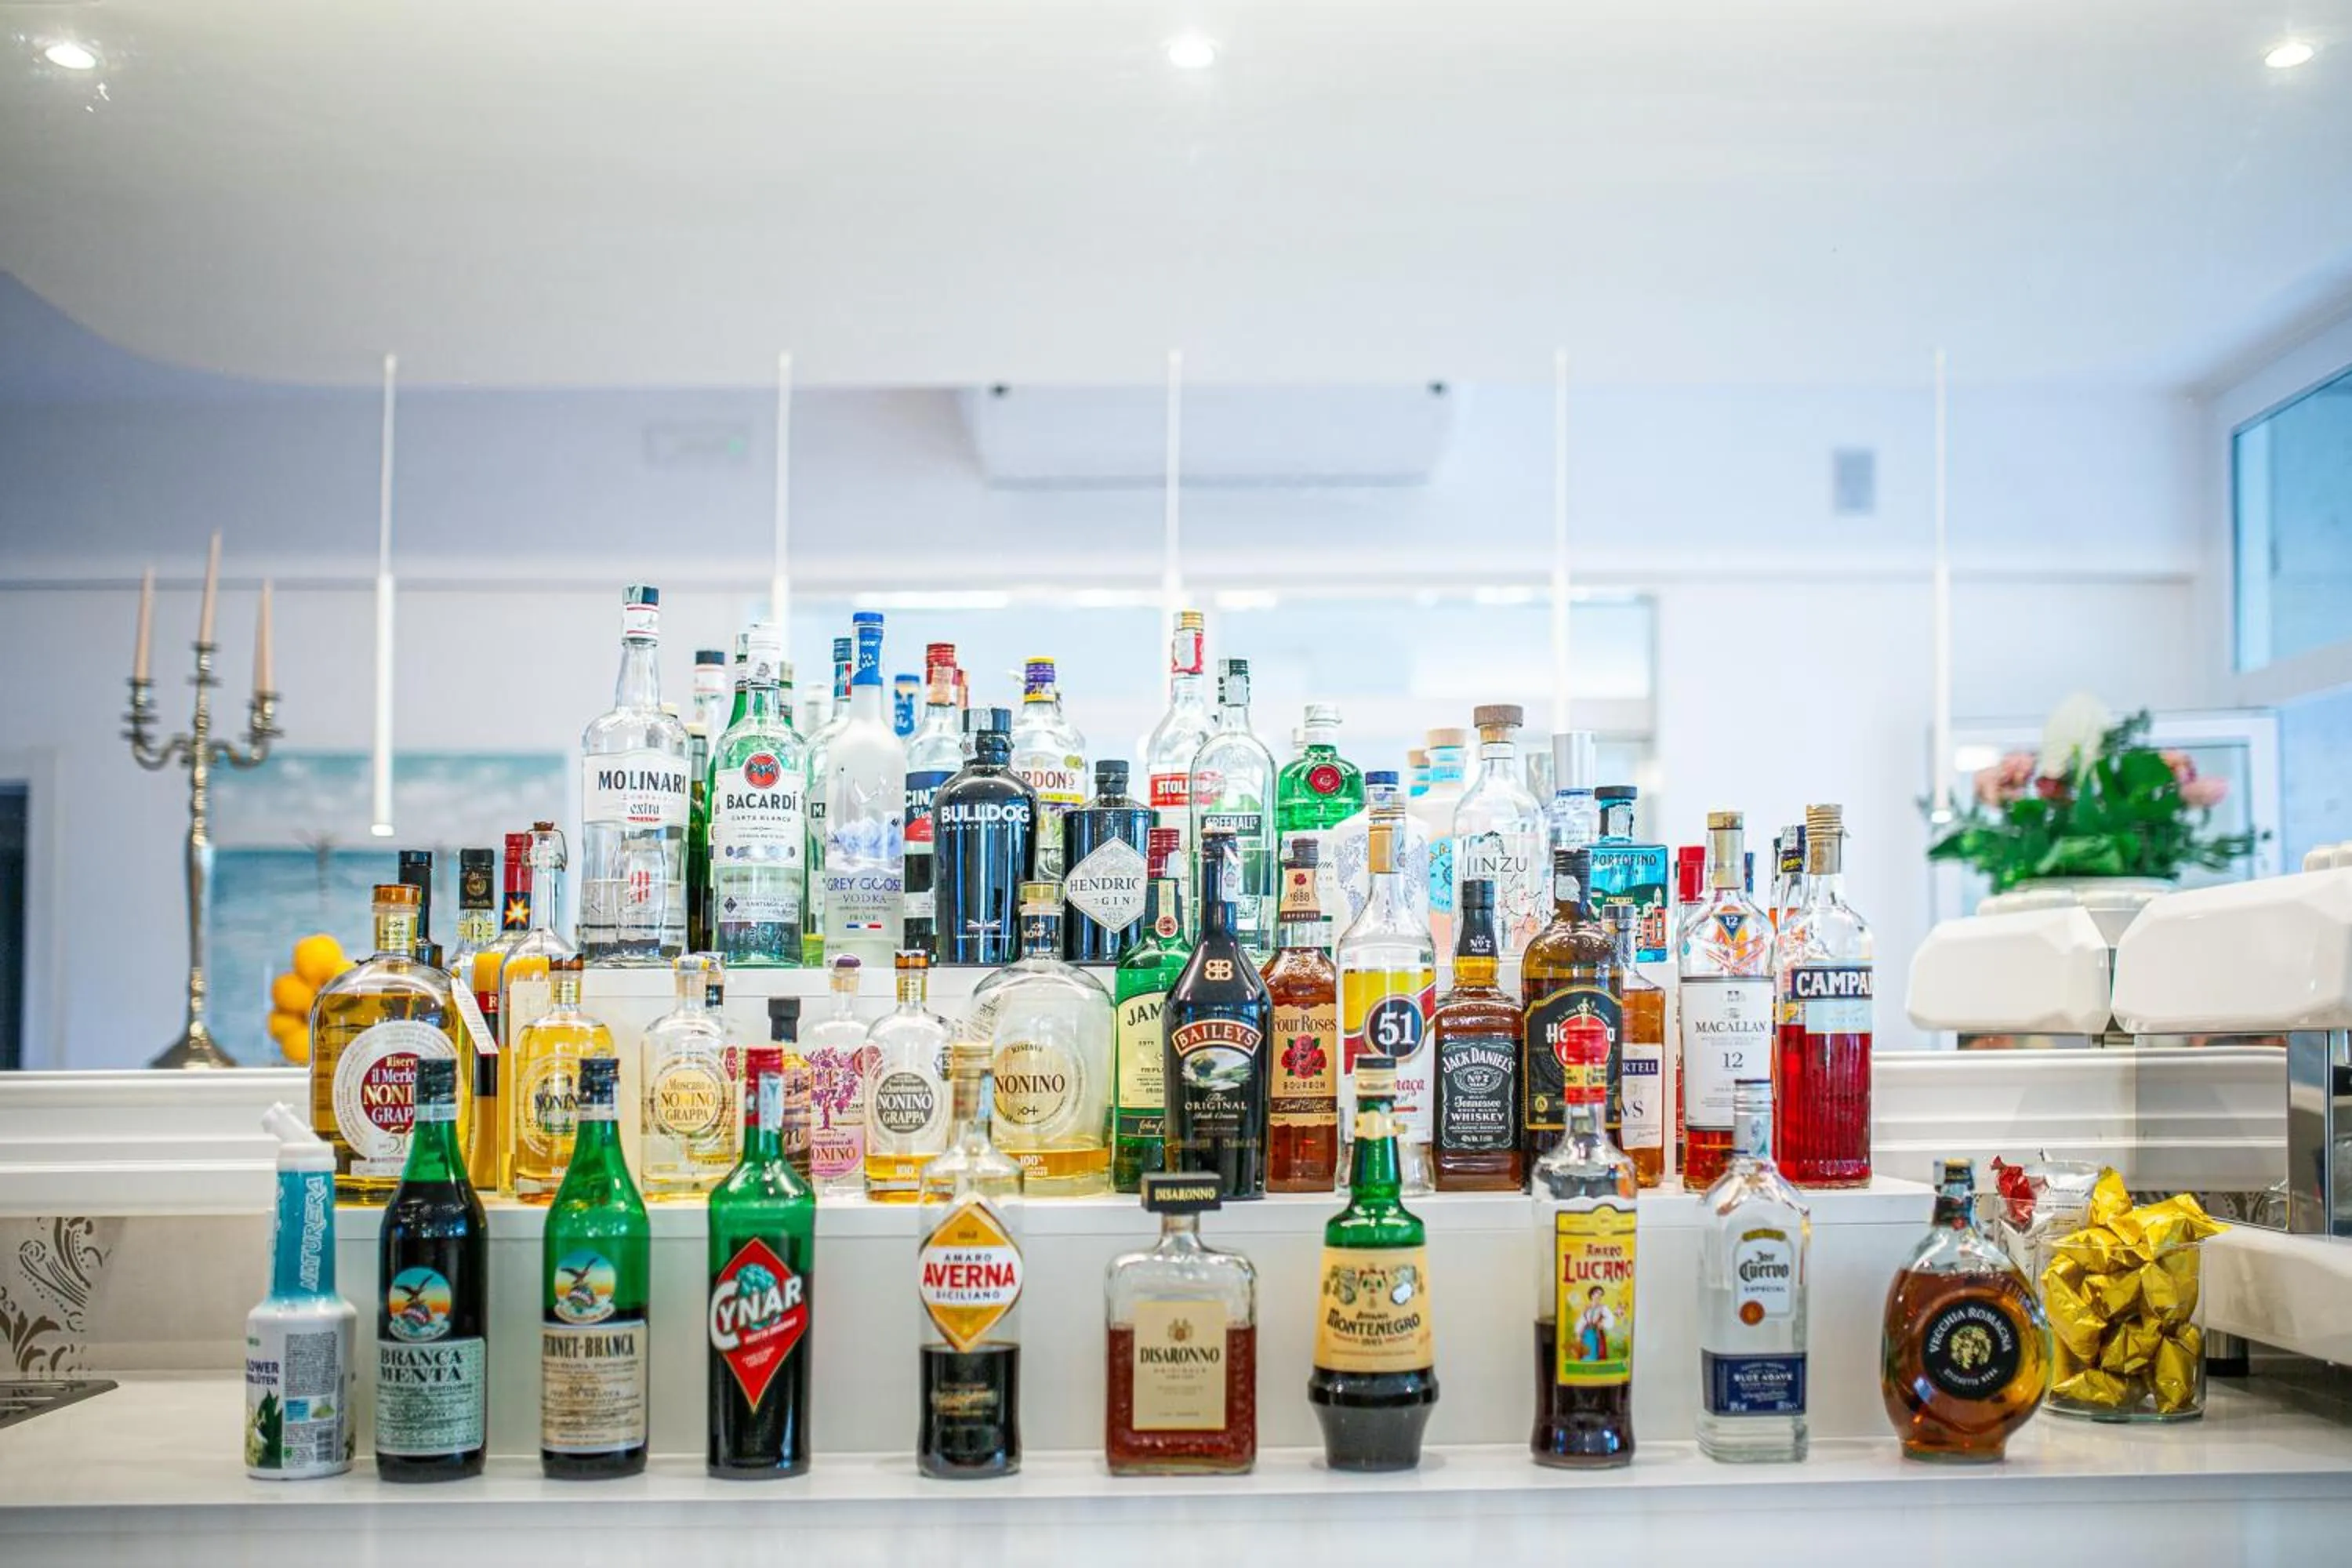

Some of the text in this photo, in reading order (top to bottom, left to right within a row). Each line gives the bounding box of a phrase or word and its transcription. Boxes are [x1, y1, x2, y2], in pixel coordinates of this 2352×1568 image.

[598, 770, 687, 793] MOLINARI
[942, 805, 1030, 823] BULLDOG
[1466, 857, 1528, 877] JINZU
[1592, 853, 1657, 866] PORTOFINO
[827, 877, 902, 892] GREY GOOSE
[1069, 877, 1141, 892] HENDRIC
[842, 892, 887, 904] VODKA
[1101, 896, 1131, 906] GIN
[1725, 916, 1739, 927] 12
[488, 994, 499, 1009] R
[1127, 1001, 1166, 1027] JAM
[1301, 1014, 1337, 1031] Roses
[1377, 1011, 1416, 1046] 51
[1695, 1021, 1768, 1033] MACALLAN
[1177, 1024, 1258, 1049] BAILEYS
[387, 1056, 416, 1068] Riserv
[1443, 1047, 1515, 1073] JACK DANIEL'S
[1623, 1062, 1657, 1074] RTELL
[1722, 1051, 1744, 1069] 12
[382, 1069, 416, 1083] Merlo
[993, 1074, 1066, 1094] NONINO
[1283, 1081, 1326, 1090] BOURBON
[363, 1083, 415, 1105] NONI
[877, 1094, 933, 1109] NONINO
[1454, 1095, 1501, 1108] Tennessee
[371, 1106, 414, 1124] GRAP
[665, 1108, 710, 1120] GRAPPA
[1185, 1102, 1247, 1112] ORIGINAL
[882, 1111, 927, 1123] GRAPPA
[1450, 1112, 1504, 1122] WHISKEY
[811, 1147, 857, 1160] ONINO
[1154, 1187, 1216, 1202] DISARONNO
[299, 1178, 328, 1293] NATURERA
[944, 1254, 992, 1262] AMARO
[922, 1262, 1016, 1289] AVERNA
[1738, 1259, 1790, 1283] Cuervo
[935, 1291, 1000, 1301] SICILIANO
[710, 1274, 803, 1351] CYNAR
[1327, 1307, 1421, 1336] MONTENEGRO
[1929, 1306, 2013, 1353] VECCHIA ROMAGNA
[543, 1334, 635, 1358] ERNET-BRANCA
[379, 1348, 463, 1367] BRANCA
[1139, 1346, 1220, 1365] DISARONNO
[379, 1366, 463, 1384] MENTA
